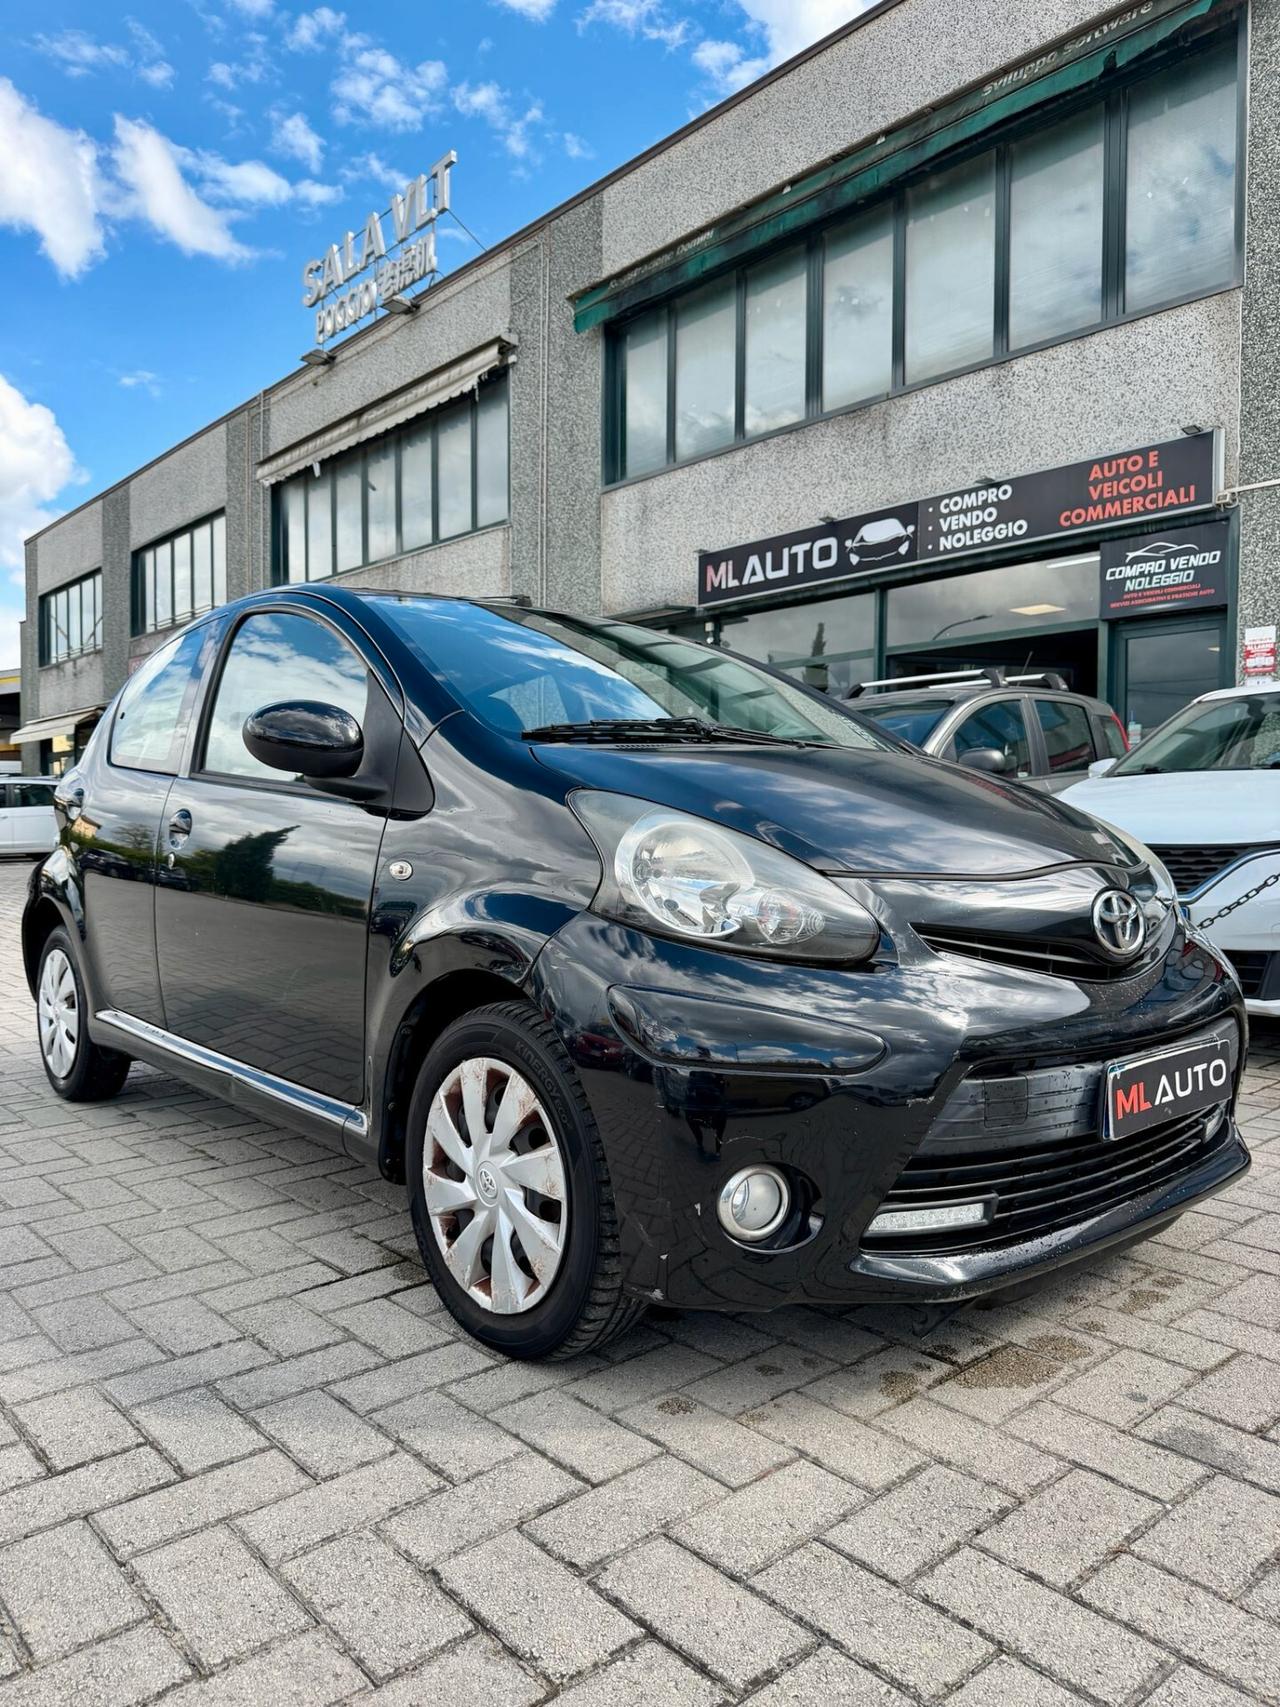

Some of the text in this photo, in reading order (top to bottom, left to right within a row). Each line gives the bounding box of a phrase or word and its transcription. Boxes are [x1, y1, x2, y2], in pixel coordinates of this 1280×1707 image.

[981, 52, 1057, 97] Sviluppo
[303, 149, 457, 308] SALA VLT
[1089, 450, 1159, 482] AUTO E
[939, 485, 1012, 514] COMPRO
[1089, 471, 1163, 500] VEICOLI
[939, 507, 998, 532] VENDO
[1059, 485, 1195, 527] COMMERCIALI
[939, 519, 1028, 551] NOLEGGIO
[1105, 550, 1221, 581] COMPRO VENDO
[1124, 570, 1195, 592] NOLEGGIO
